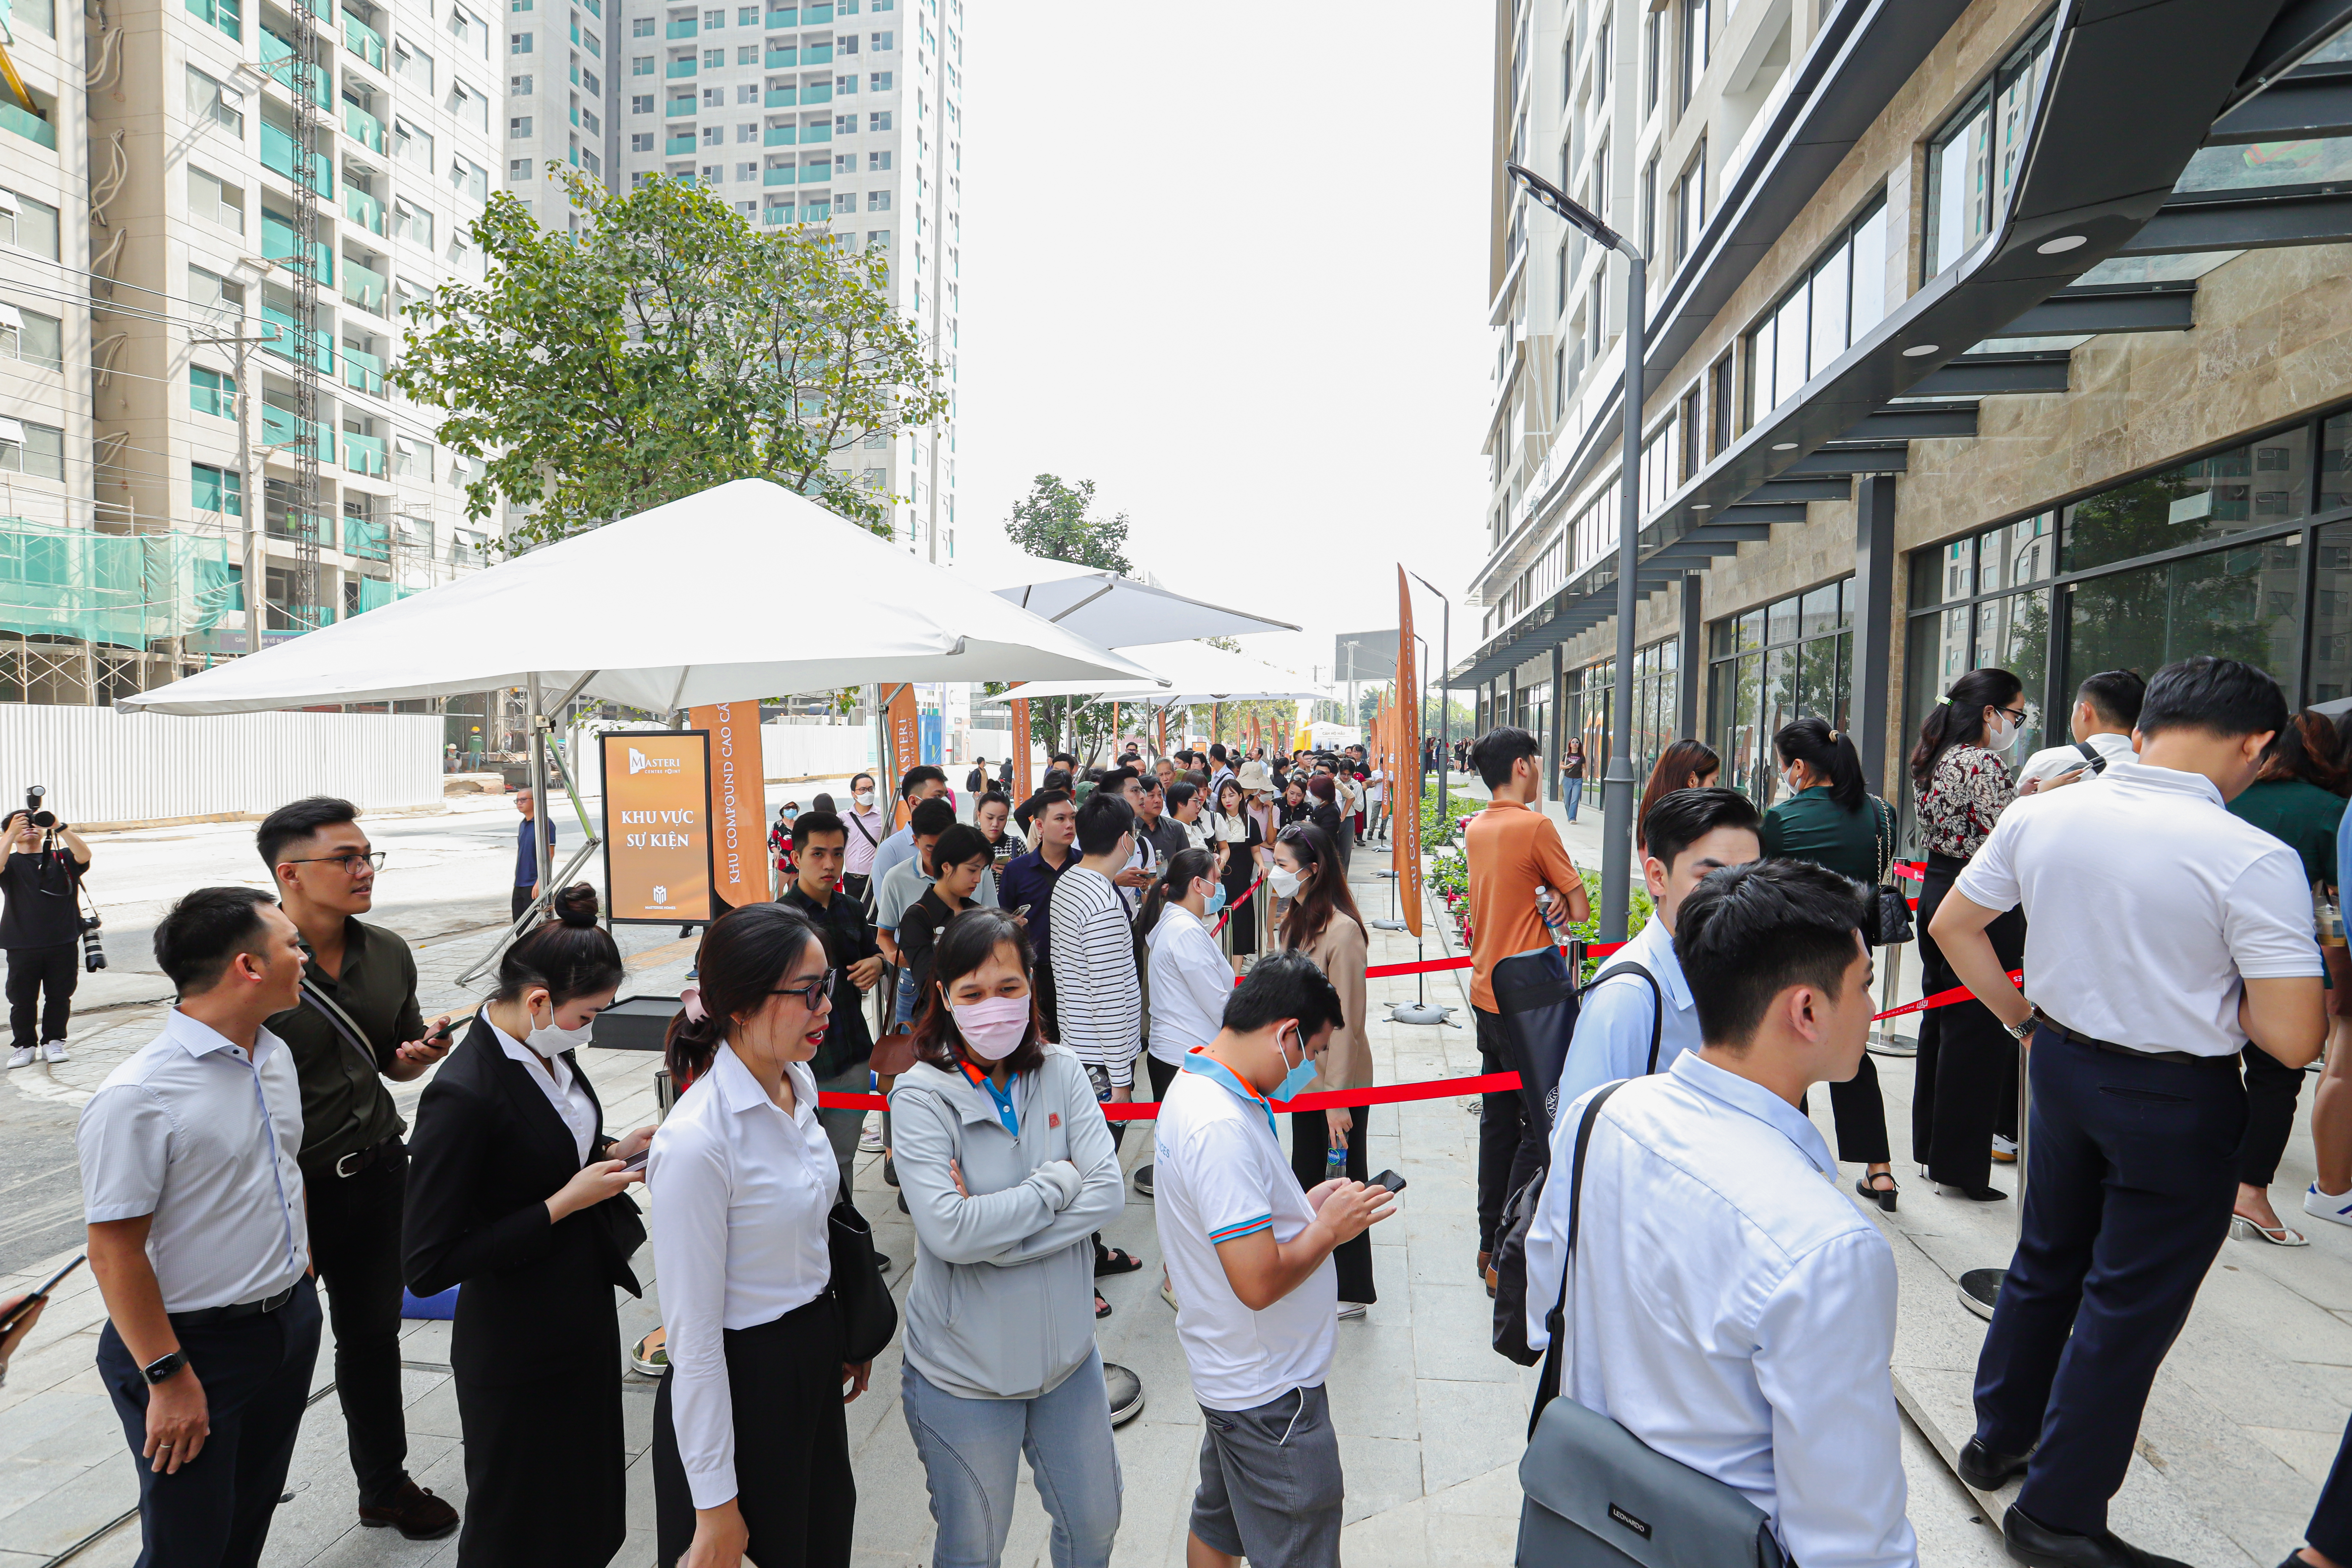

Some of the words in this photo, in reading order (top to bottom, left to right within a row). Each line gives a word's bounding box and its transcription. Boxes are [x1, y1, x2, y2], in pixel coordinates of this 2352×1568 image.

[716, 703, 730, 723] CẤ
[720, 726, 733, 758] CAO
[631, 756, 680, 768] MASTERI
[723, 761, 738, 849] COMPOUND
[621, 810, 657, 824] KHU
[660, 808, 694, 827] VỰC
[626, 831, 647, 849] SỰ
[650, 831, 689, 849] KIỆN
[728, 853, 740, 884] KHU
[1613, 1508, 1645, 1532] LEONARDO
